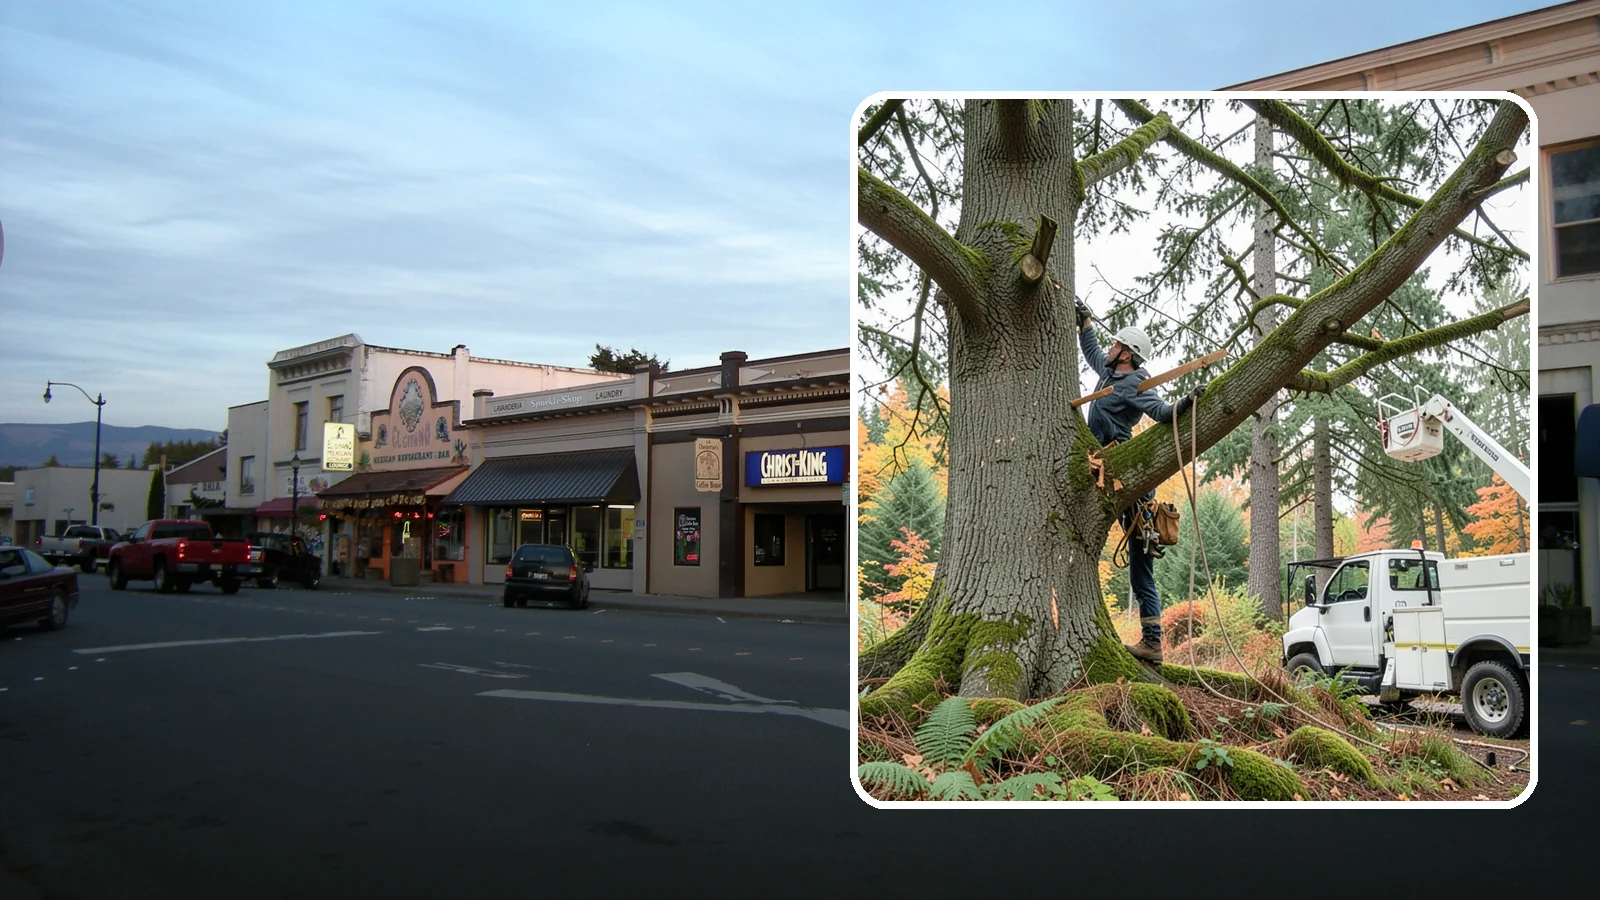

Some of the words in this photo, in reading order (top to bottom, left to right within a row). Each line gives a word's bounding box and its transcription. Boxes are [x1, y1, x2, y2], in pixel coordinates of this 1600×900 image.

[562, 394, 583, 404] Shop
[595, 389, 624, 400] LAUNDRY
[493, 403, 523, 413] LAVANDERIA
[374, 455, 396, 464] MEXICAN
[397, 451, 434, 463] RESTAURANT
[437, 450, 450, 459] BAR
[761, 452, 797, 477] CHRIST
[799, 450, 827, 476] KING
[696, 480, 709, 489] Coffee
